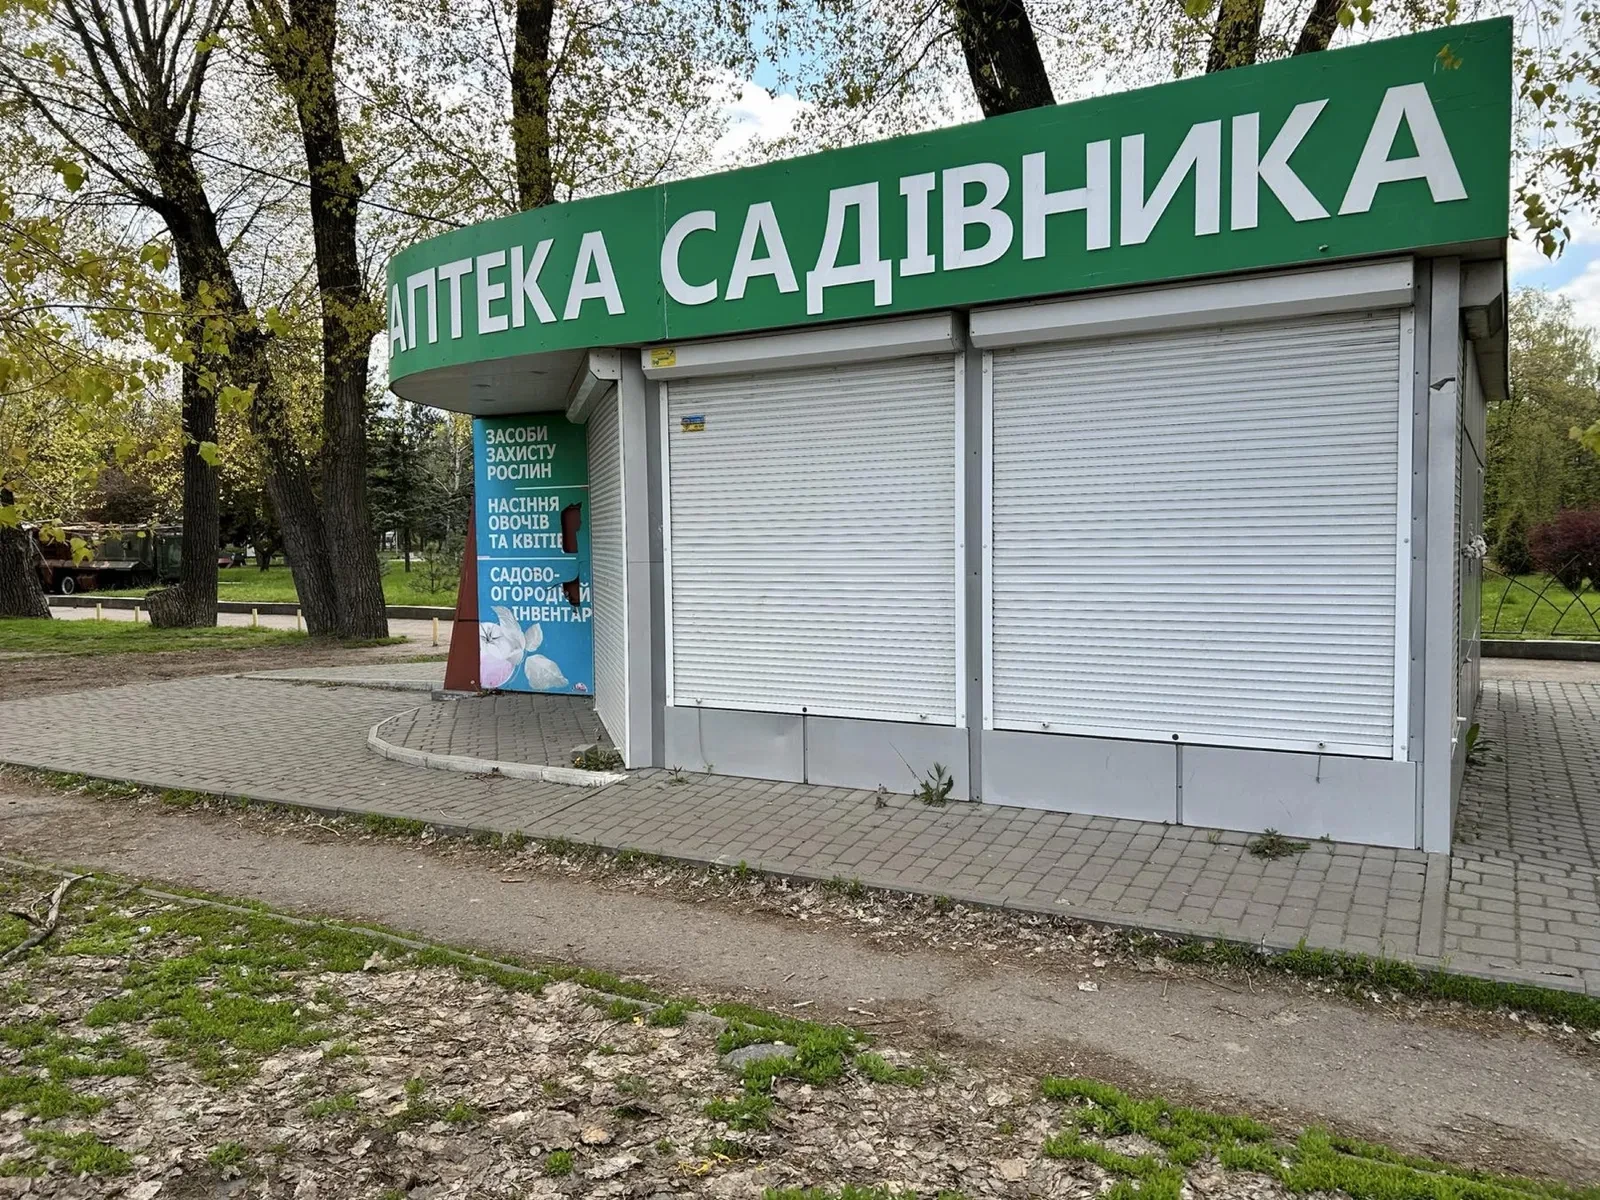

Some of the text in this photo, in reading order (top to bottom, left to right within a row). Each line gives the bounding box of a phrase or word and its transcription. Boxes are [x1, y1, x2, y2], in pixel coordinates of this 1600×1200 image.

[389, 82, 1468, 359] АПТЕКА САДІВНИКА
[486, 426, 548, 445] ЗАСОБИ
[486, 444, 556, 463] ЗАХИСТУ
[487, 462, 552, 480] РОСЛИН
[488, 496, 559, 513] НАСІННЯ
[489, 514, 550, 531] ОВОЧІВ
[489, 533, 508, 549] ТА
[490, 566, 560, 584] САДОВО-
[512, 605, 593, 622] ІНВЕНТАР
